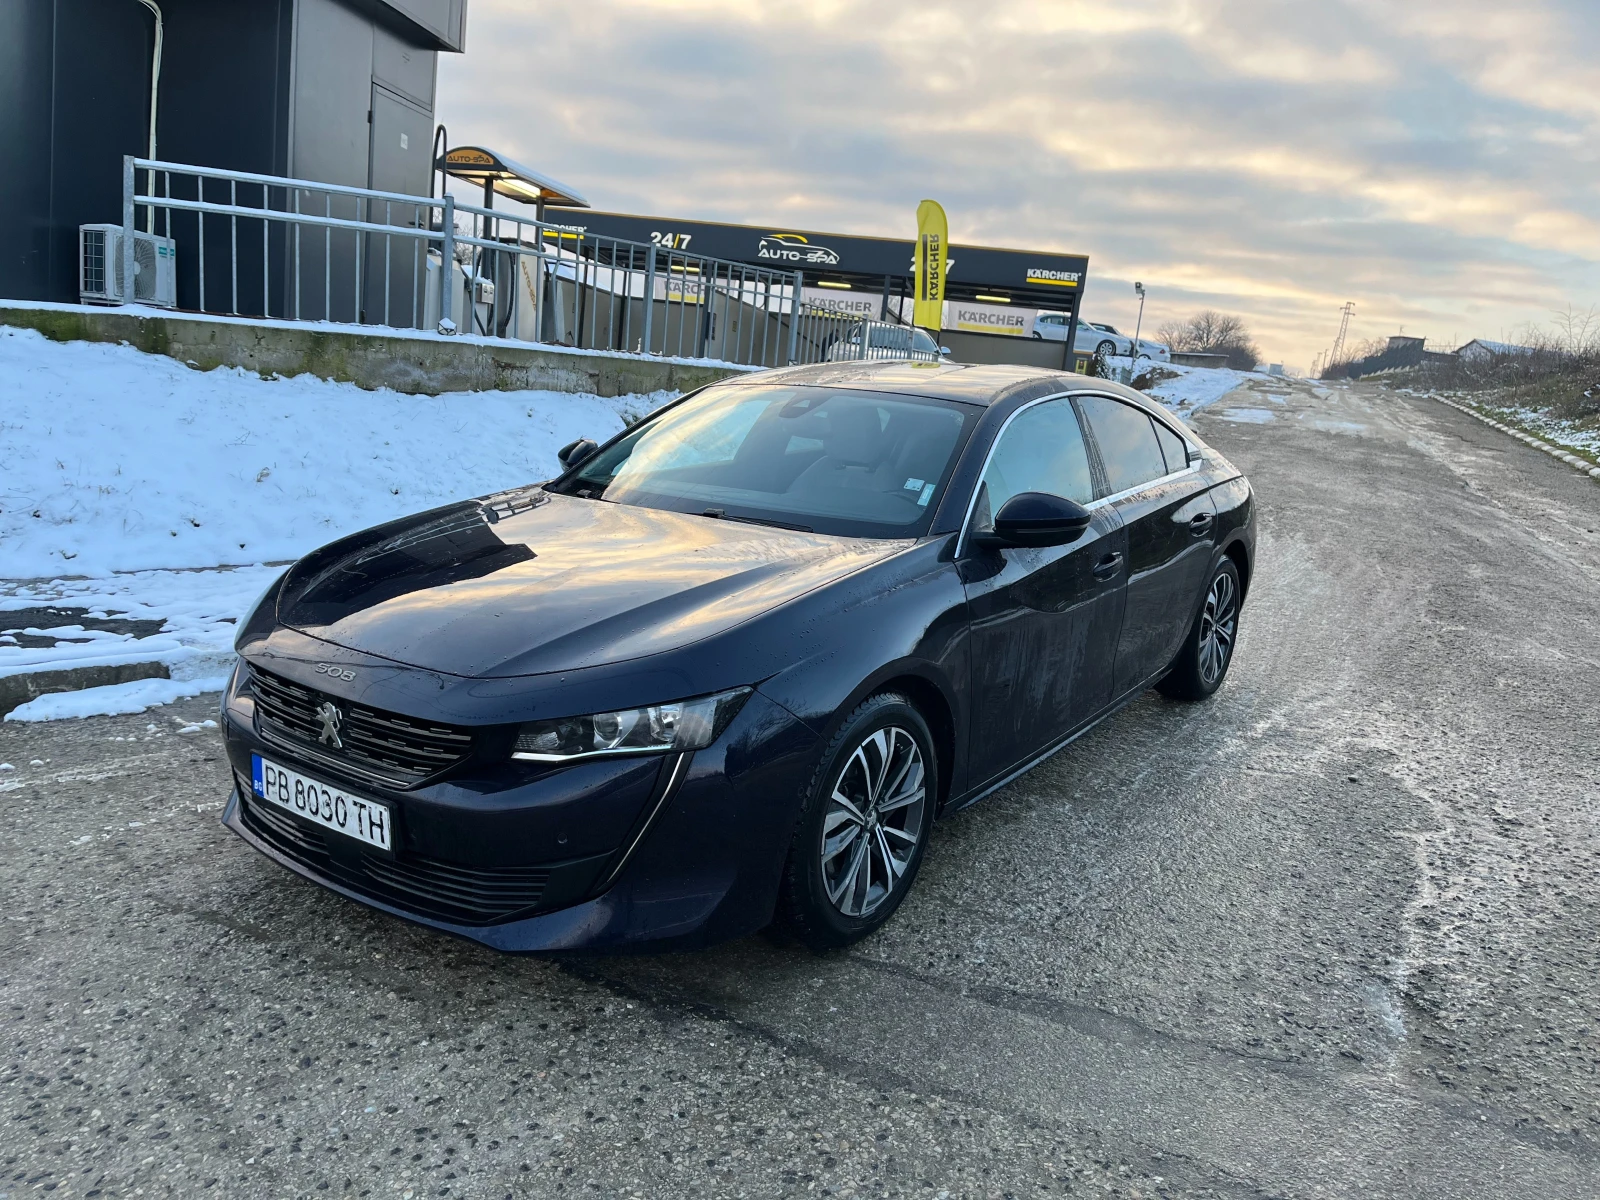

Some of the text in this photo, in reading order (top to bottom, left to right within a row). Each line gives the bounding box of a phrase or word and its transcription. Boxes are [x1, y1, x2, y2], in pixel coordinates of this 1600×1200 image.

[650, 231, 692, 249] 24/7
[757, 248, 838, 265] AUTO-SPA
[1027, 268, 1079, 282] KÄRCHER
[958, 310, 1025, 326] KÄRCHER
[315, 662, 357, 682] 508
[254, 779, 263, 792] BG
[265, 763, 386, 844] PB 8030 TH
